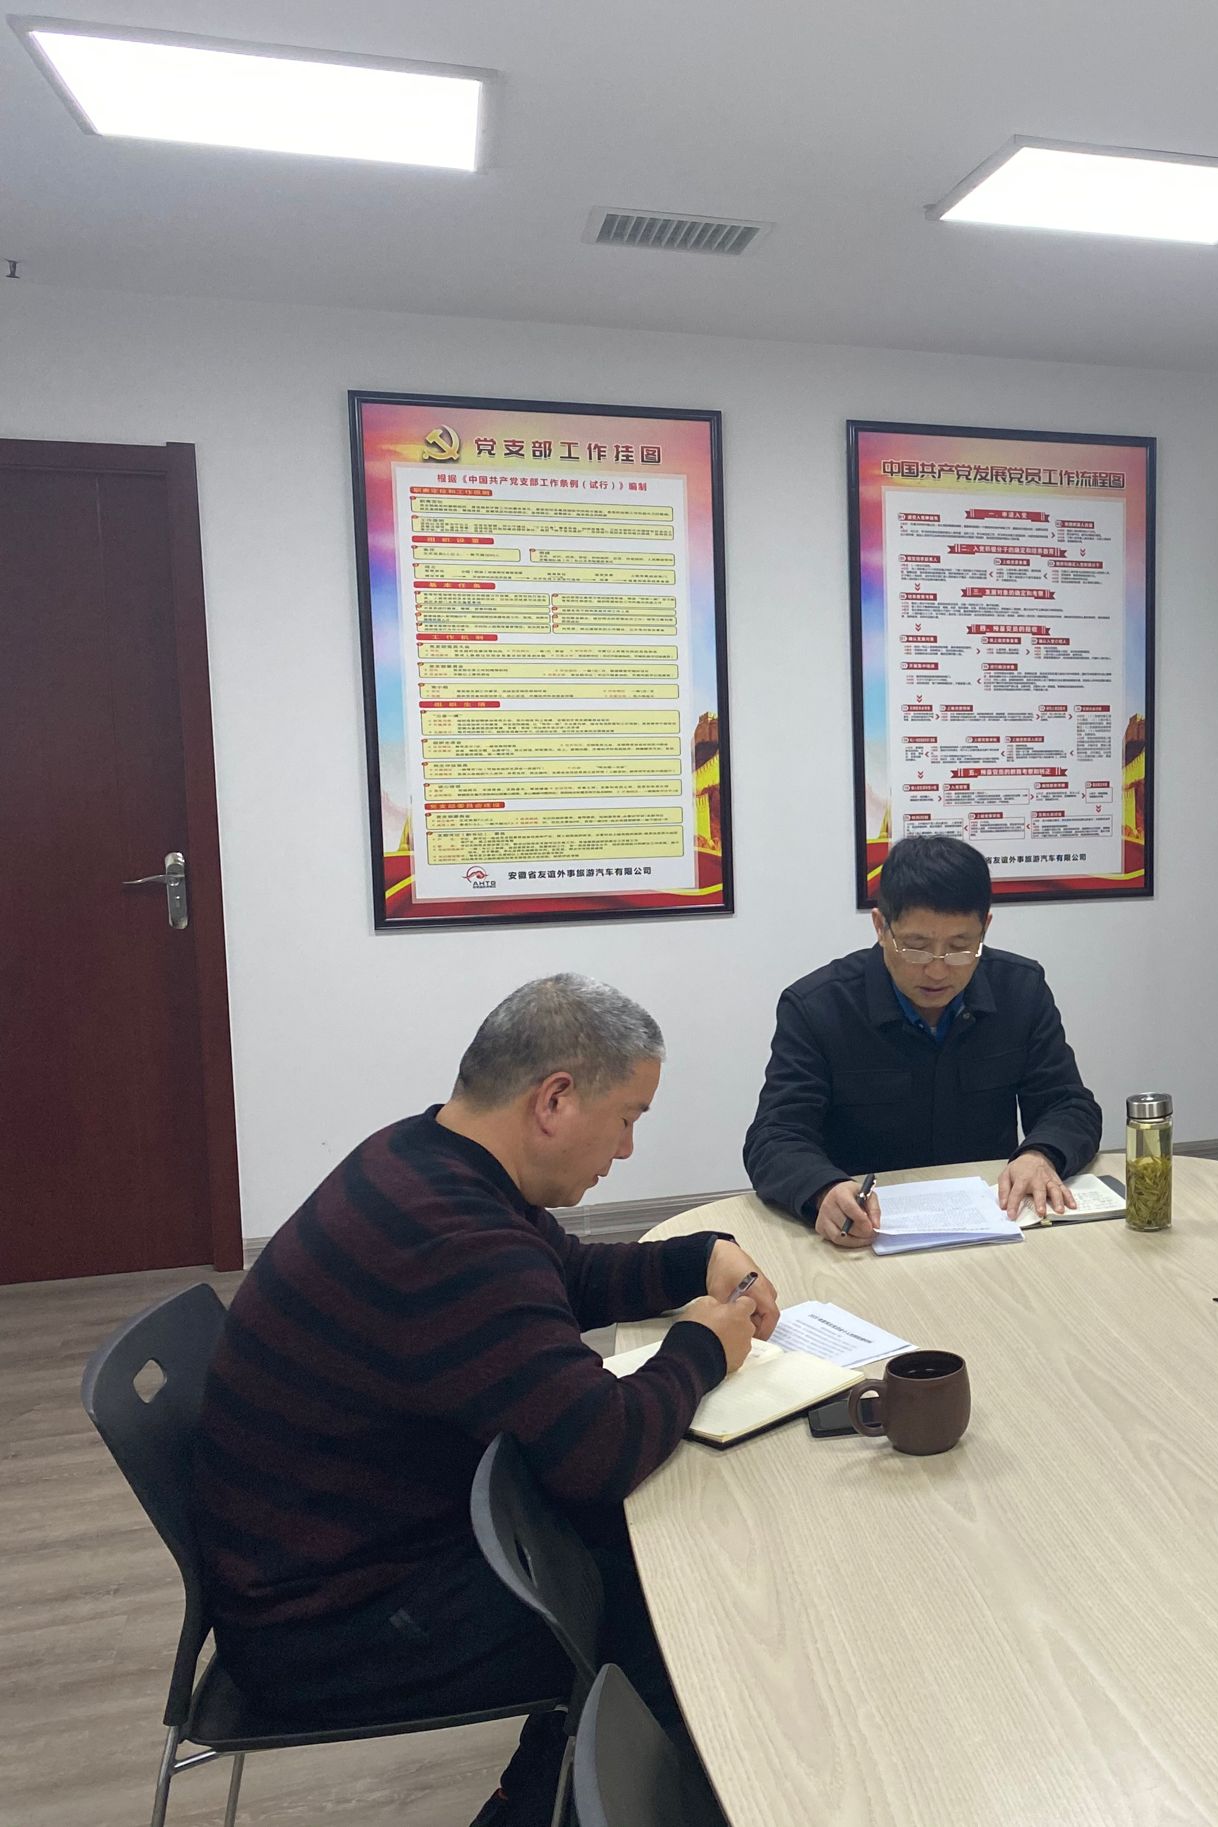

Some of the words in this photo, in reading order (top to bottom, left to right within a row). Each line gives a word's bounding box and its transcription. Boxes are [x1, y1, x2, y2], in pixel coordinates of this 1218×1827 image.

[475, 437, 662, 465] 党支部工作挂图
[882, 460, 1126, 489] 中国共产党发展党员工作流程图
[508, 867, 652, 880] 安徽省友谊外事旅游汽车有限公司
